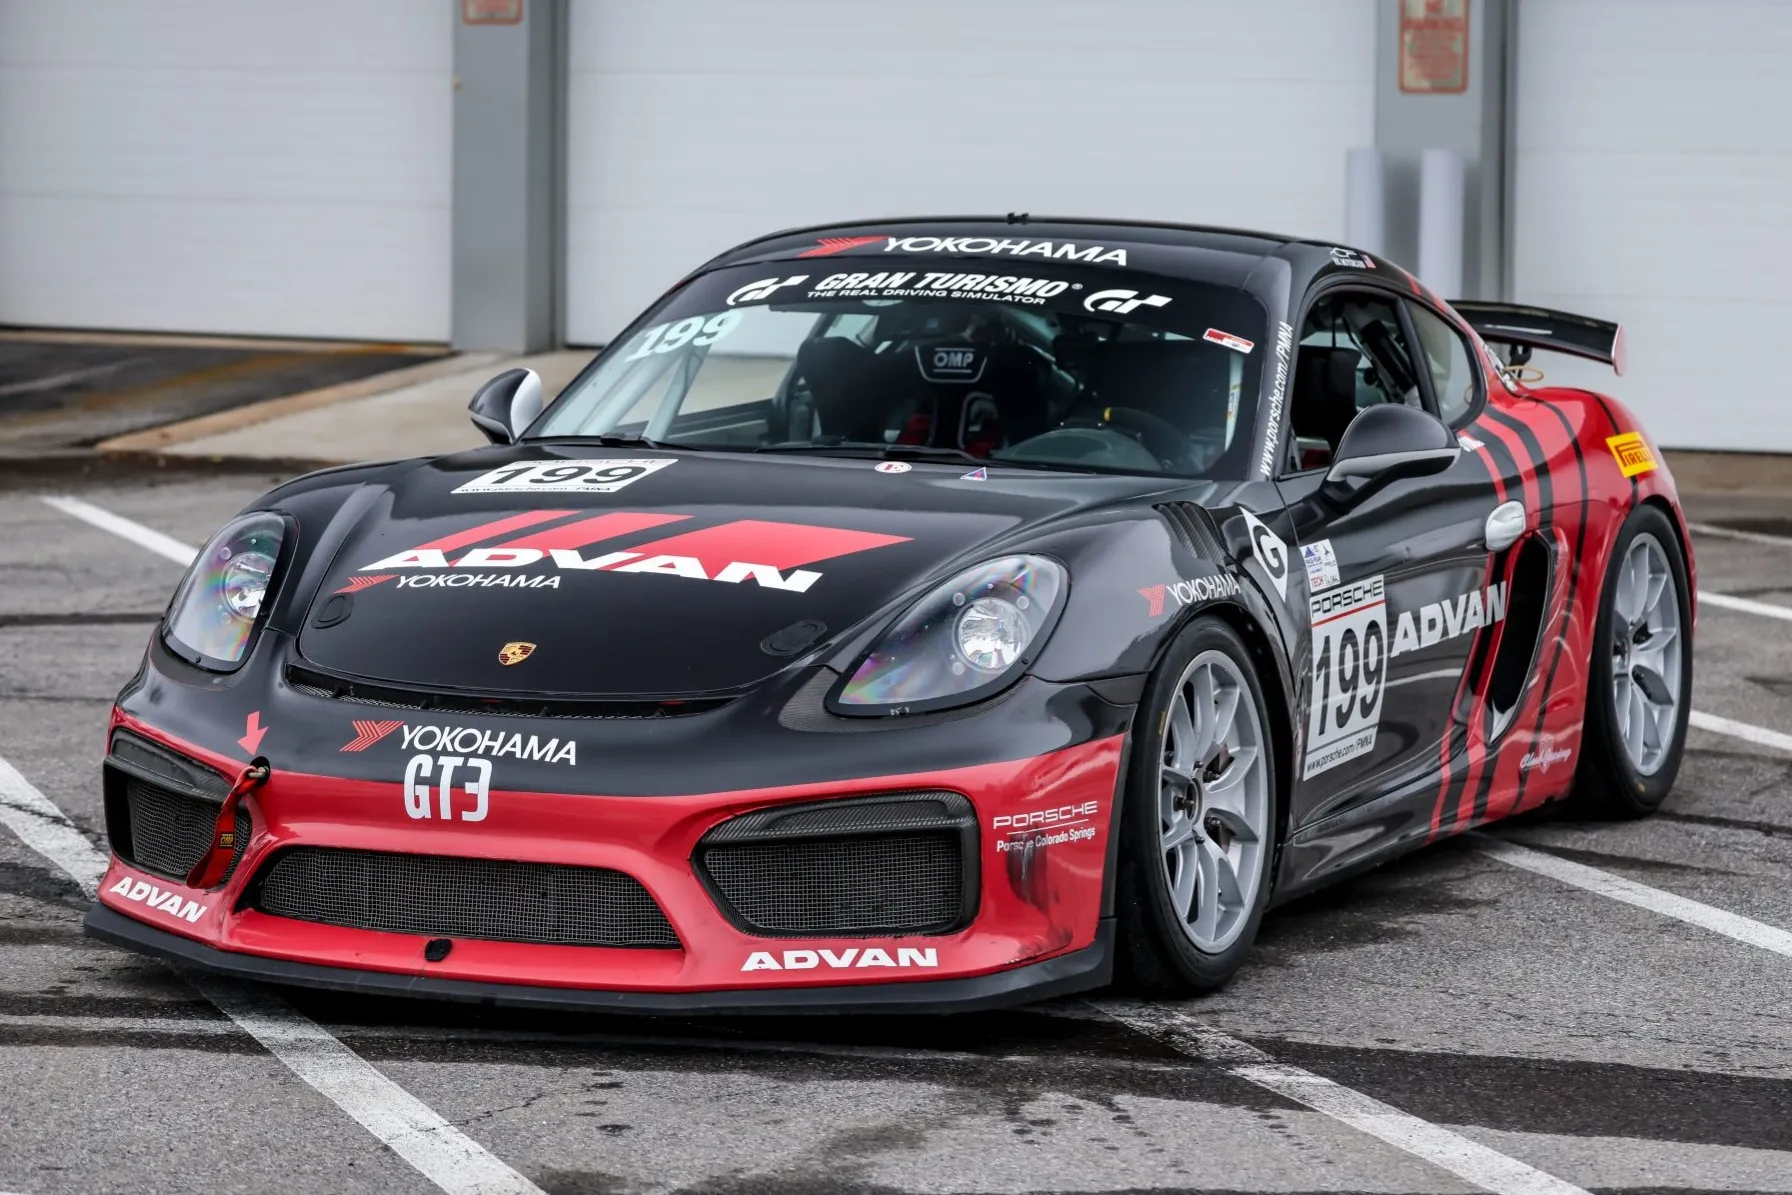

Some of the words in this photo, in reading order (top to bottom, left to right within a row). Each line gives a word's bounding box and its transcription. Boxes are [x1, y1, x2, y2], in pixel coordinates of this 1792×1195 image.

[884, 236, 1127, 267] YOKOHAMA
[807, 291, 835, 299] THE
[838, 288, 879, 297] REAL
[881, 288, 948, 298] DRIVING
[950, 290, 1047, 306] SIMULATOR
[814, 271, 917, 291] GRAN
[624, 307, 745, 363] 199
[933, 351, 975, 368] OMP
[1259, 320, 1294, 477] www.porsche.com/PMNA
[490, 465, 648, 485] 199
[357, 547, 823, 593] ADVAN
[1252, 524, 1286, 580] G
[396, 574, 561, 589] YOKOHAMA
[1166, 573, 1242, 606] YOKOHAMA
[1311, 579, 1384, 618] PORSCHE
[1390, 580, 1507, 658] ADVAN
[1315, 619, 1384, 736] 199
[400, 724, 577, 767] YOKOHAMA
[403, 754, 493, 822] GT3
[993, 800, 1098, 829] PORSCHE
[1035, 831, 1069, 848] Colorado
[1069, 826, 1096, 844] Springs
[109, 876, 208, 924] ADVAN
[740, 947, 939, 972] ADVAN
